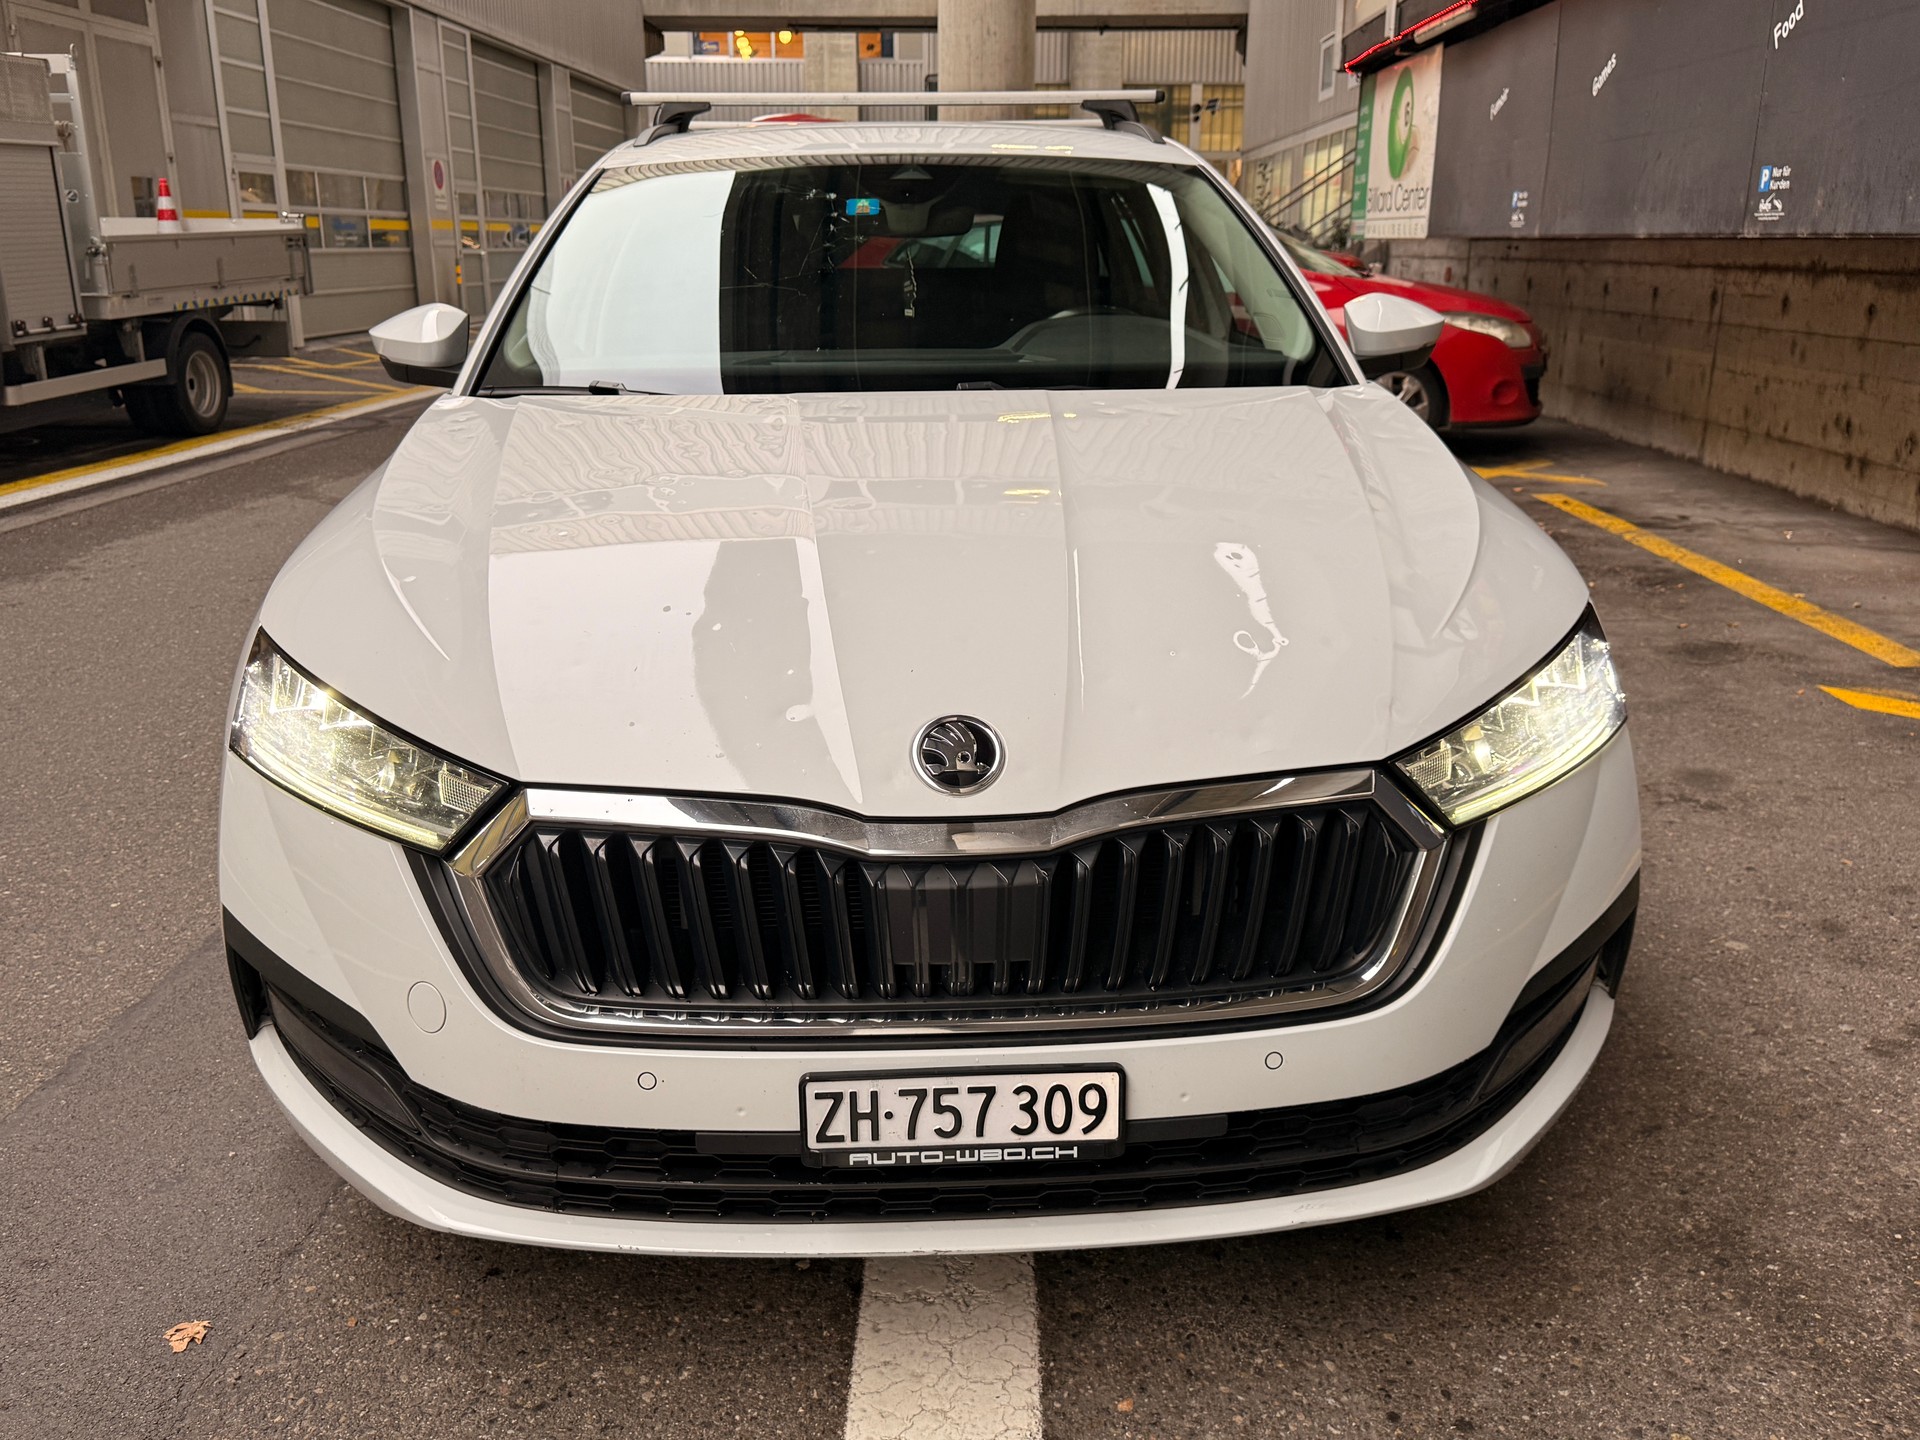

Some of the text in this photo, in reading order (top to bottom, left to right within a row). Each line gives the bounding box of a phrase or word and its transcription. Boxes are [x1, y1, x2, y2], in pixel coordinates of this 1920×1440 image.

[1773, 0, 1804, 50] Food
[1592, 53, 1617, 97] Games
[1772, 166, 1782, 178] Nur
[1394, 182, 1430, 213] Center
[1010, 1083, 1108, 1136] 309
[849, 1146, 1079, 1165] AUTO-WBO.CH
